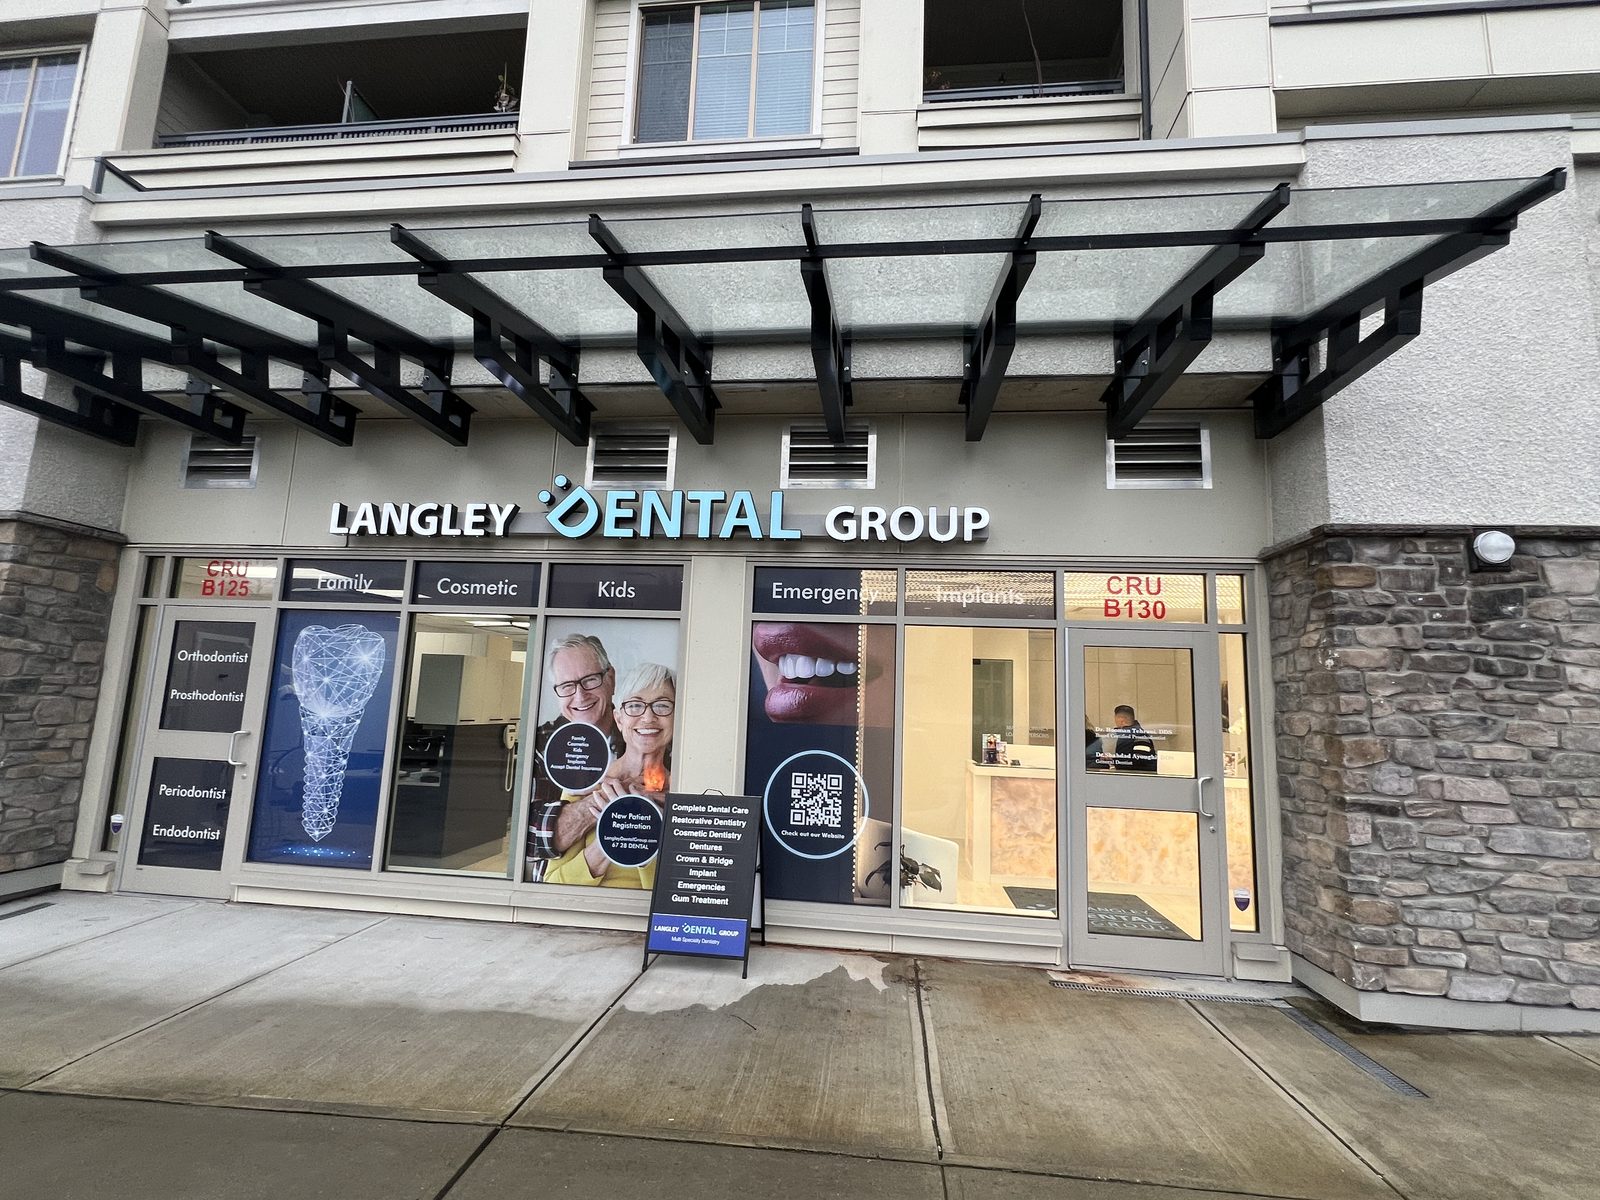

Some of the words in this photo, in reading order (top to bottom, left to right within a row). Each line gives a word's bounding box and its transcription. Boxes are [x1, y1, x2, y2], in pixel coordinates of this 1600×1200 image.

[329, 502, 518, 537] LANGLEY
[545, 484, 803, 541] DENTAL
[825, 506, 990, 543] GROUP
[207, 560, 250, 577] CRU
[202, 579, 250, 597] B125
[317, 573, 373, 593] Family
[436, 578, 518, 596] Cosmetic
[1107, 575, 1162, 596] CRU
[597, 581, 636, 599] Kids
[772, 582, 880, 605] Emergency
[937, 585, 1025, 608] Implants
[1104, 598, 1166, 619] B130
[177, 649, 249, 664] Orthodontist
[170, 689, 244, 702] Prosthodontist
[159, 784, 227, 800] Periodontist
[671, 803, 706, 813] Complete
[707, 805, 730, 813] Dental
[628, 813, 651, 821] Patient
[671, 816, 712, 825] Restorative
[713, 818, 747, 828] Dentistry
[152, 824, 221, 840] Endodontist
[612, 821, 651, 830] Registration
[673, 828, 707, 838] Cosmetic
[709, 831, 742, 840] Dentistry
[689, 842, 723, 851] Dentures
[675, 854, 700, 863] Crown
[701, 856, 707, 864] &
[709, 856, 734, 866] Bridge
[689, 868, 717, 878] Implant
[677, 881, 726, 892] Emergencies
[671, 894, 690, 902] Gum
[691, 895, 729, 905] Treatment
[1088, 907, 1149, 915] ANGLEY
[1088, 914, 1162, 924] ENTAL
[654, 925, 679, 933] LANGLEY
[682, 924, 717, 935] DENTAL
